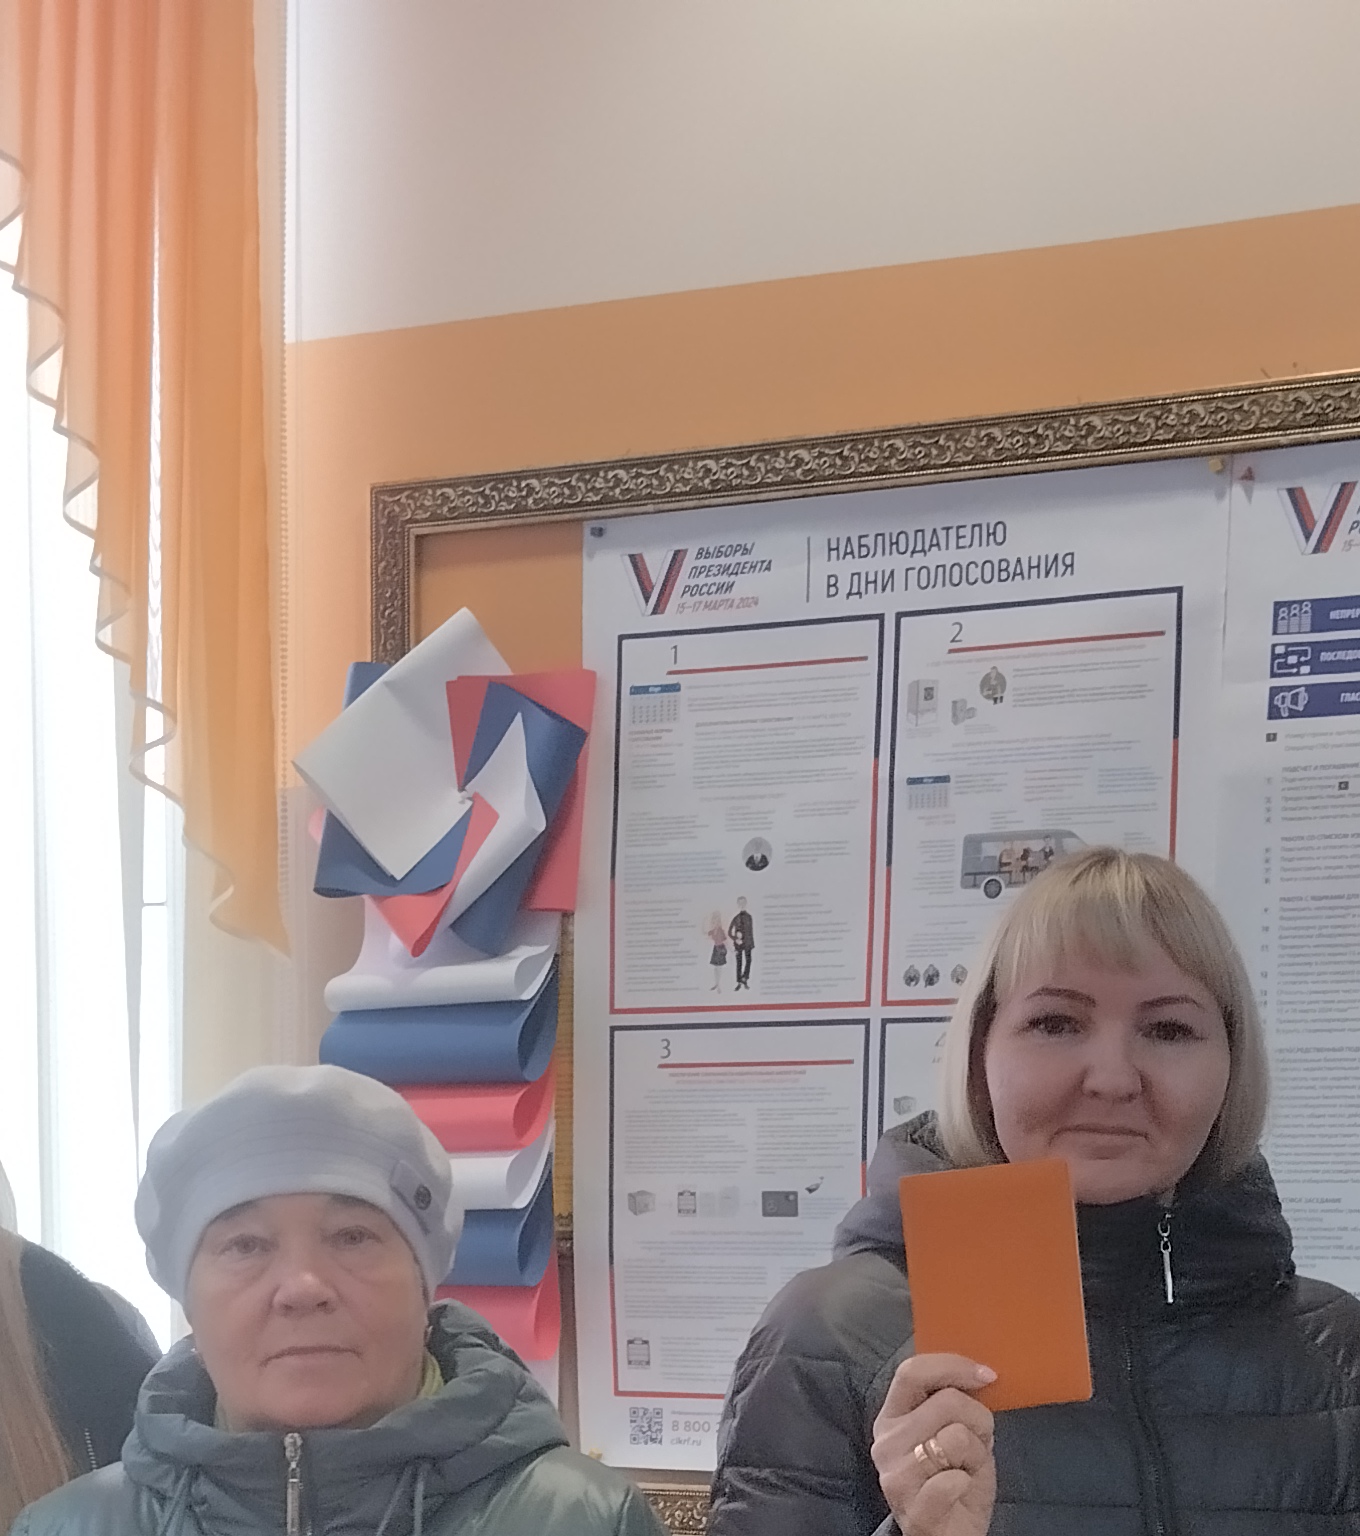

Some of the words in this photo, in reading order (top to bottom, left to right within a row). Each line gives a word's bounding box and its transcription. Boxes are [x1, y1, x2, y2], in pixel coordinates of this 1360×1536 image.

[694, 542, 756, 561] ВЫБОРЫ
[826, 521, 1008, 562] НАБЛЮДАТЕЛЮ
[687, 559, 773, 580] ПРЕЗИДЕНТА
[826, 573, 840, 599] В
[846, 568, 896, 600] ДНИ
[904, 551, 1076, 592] ГОЛОСОВАНИЯ
[680, 580, 736, 599] РОССИИ
[702, 598, 736, 612] МАРТА
[949, 621, 964, 644] 2
[670, 644, 679, 665] 1
[659, 1038, 672, 1060] 3
[671, 1420, 680, 1432] 8
[683, 1420, 711, 1433] 800
